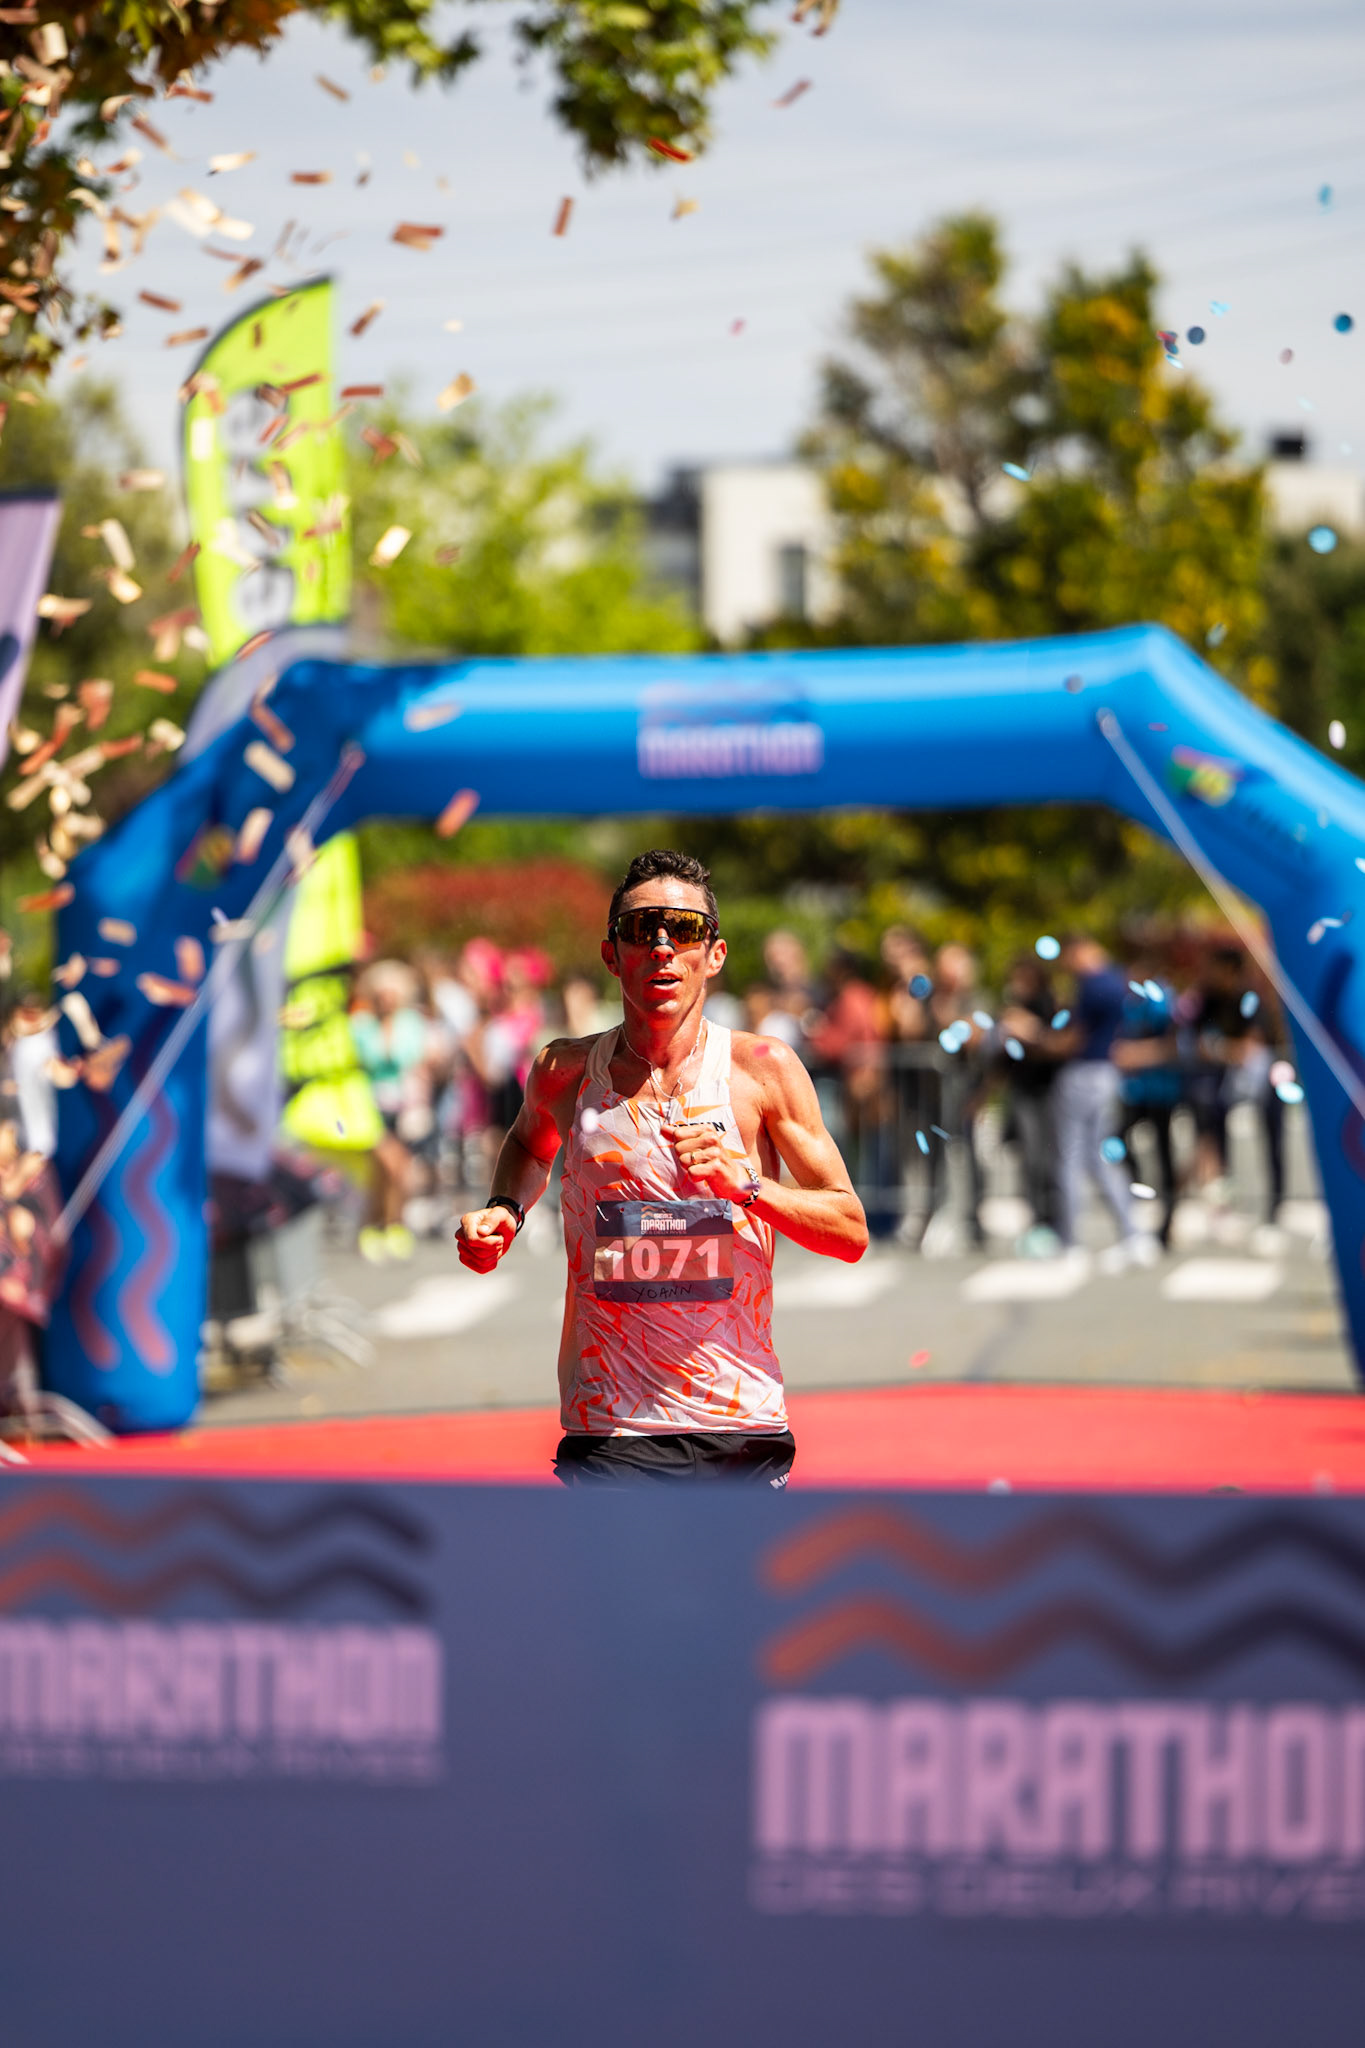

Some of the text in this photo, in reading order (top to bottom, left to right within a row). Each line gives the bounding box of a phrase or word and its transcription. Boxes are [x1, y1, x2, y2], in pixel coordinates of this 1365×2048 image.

[641, 1219, 687, 1231] MARATHON
[605, 1238, 719, 1280] 1071
[630, 1284, 692, 1303] YOANN
